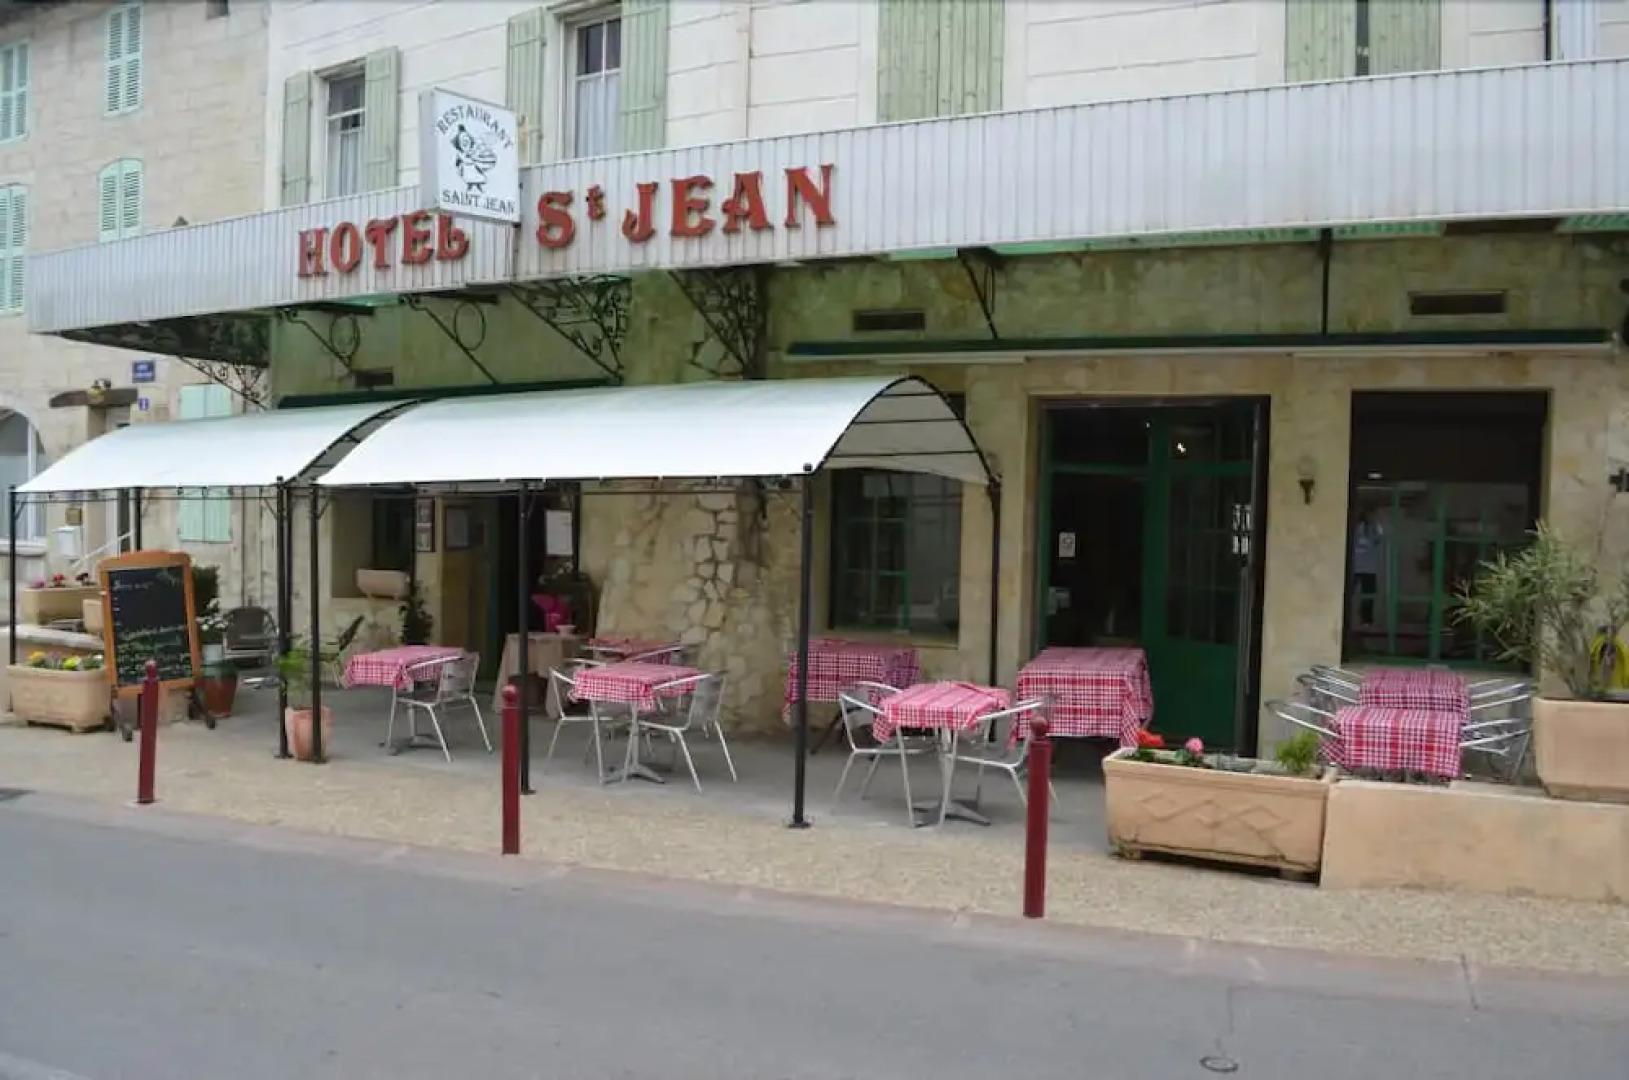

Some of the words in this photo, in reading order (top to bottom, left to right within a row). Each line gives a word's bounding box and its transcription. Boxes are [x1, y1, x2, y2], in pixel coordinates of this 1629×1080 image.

[436, 104, 514, 150] RESTAURANT
[296, 209, 470, 278] HOTEL
[622, 164, 835, 243] JEAN
[442, 189, 480, 208] SAINT
[483, 197, 516, 214] JEAN
